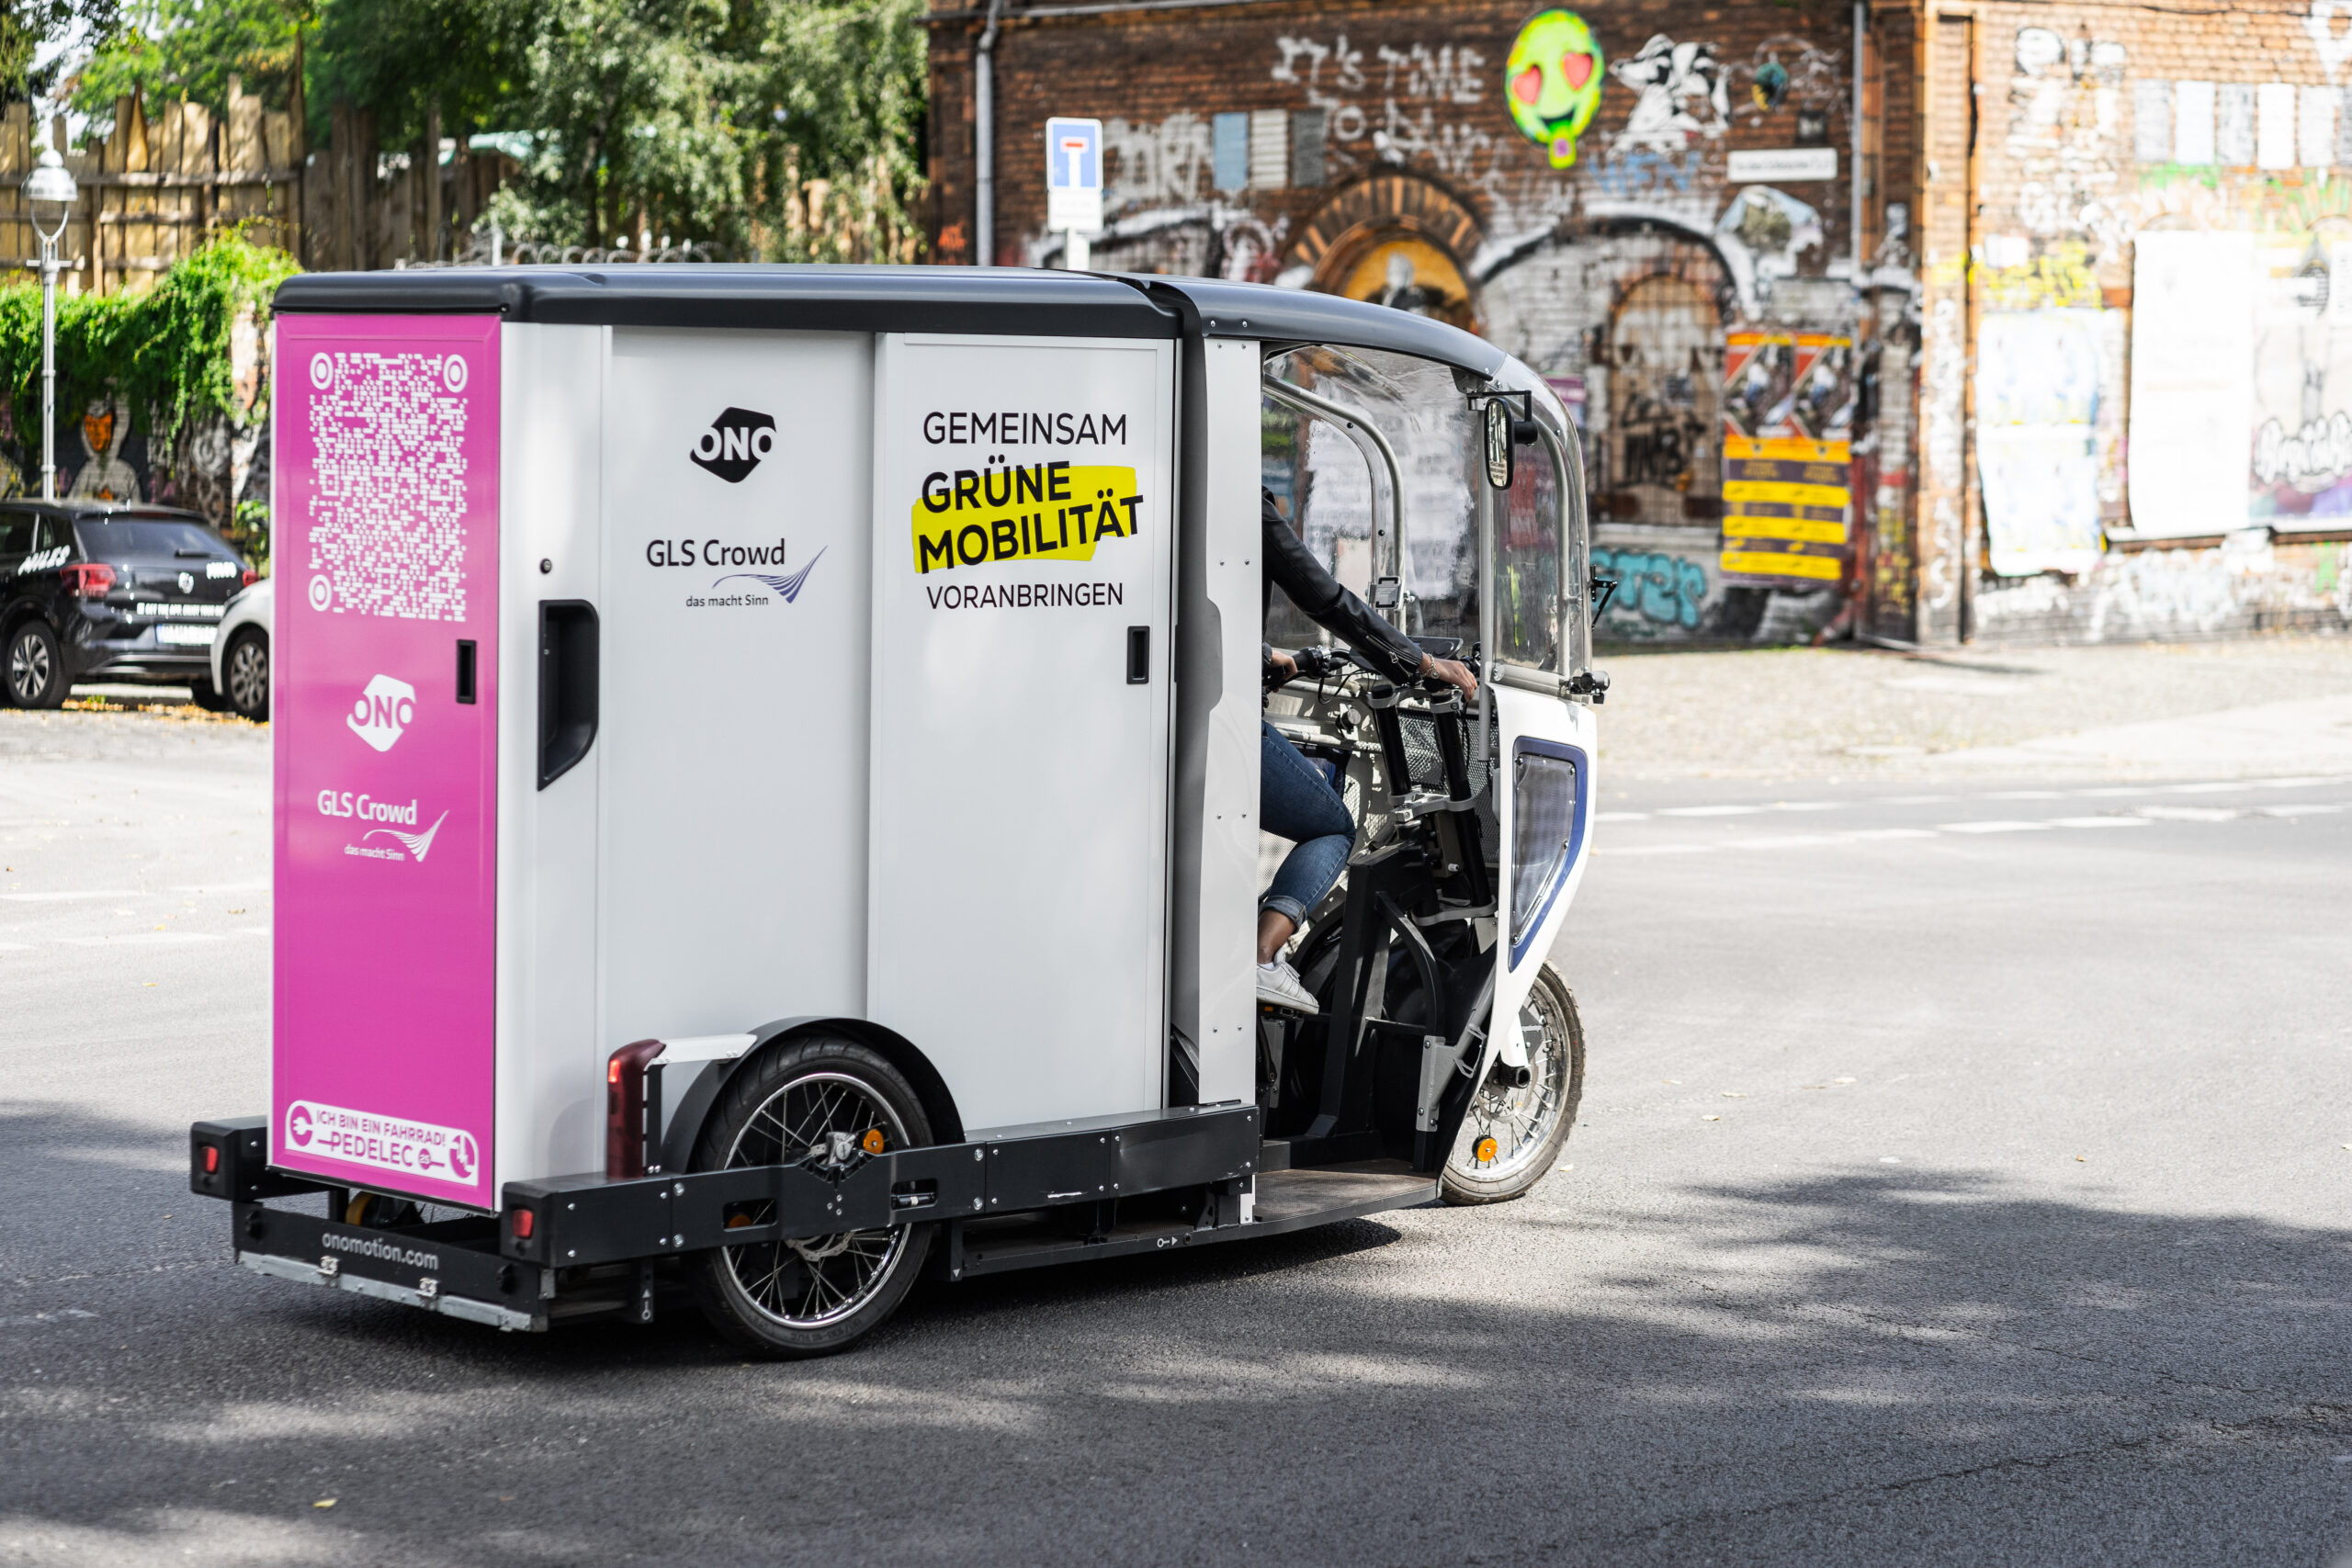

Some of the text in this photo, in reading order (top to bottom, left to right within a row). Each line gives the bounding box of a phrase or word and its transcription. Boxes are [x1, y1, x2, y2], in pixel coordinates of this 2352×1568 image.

[692, 425, 778, 461] ONO
[922, 411, 1126, 446] GEMEINSAM
[922, 454, 1071, 513] GRÜNE
[918, 488, 1144, 574] MOBILITÄT
[646, 537, 785, 567] GLS Crowd
[685, 593, 769, 607] das macht Sinn
[926, 582, 1123, 610] VORANBRINGEN
[350, 694, 417, 729] ONO
[317, 789, 417, 825] GLS Crowd
[344, 843, 405, 862] das macht Sinn
[316, 1110, 446, 1147] ICH BIN EIN FAHRRAD!
[330, 1131, 413, 1168] PEDELEC
[322, 1232, 439, 1270] onomotion.com
